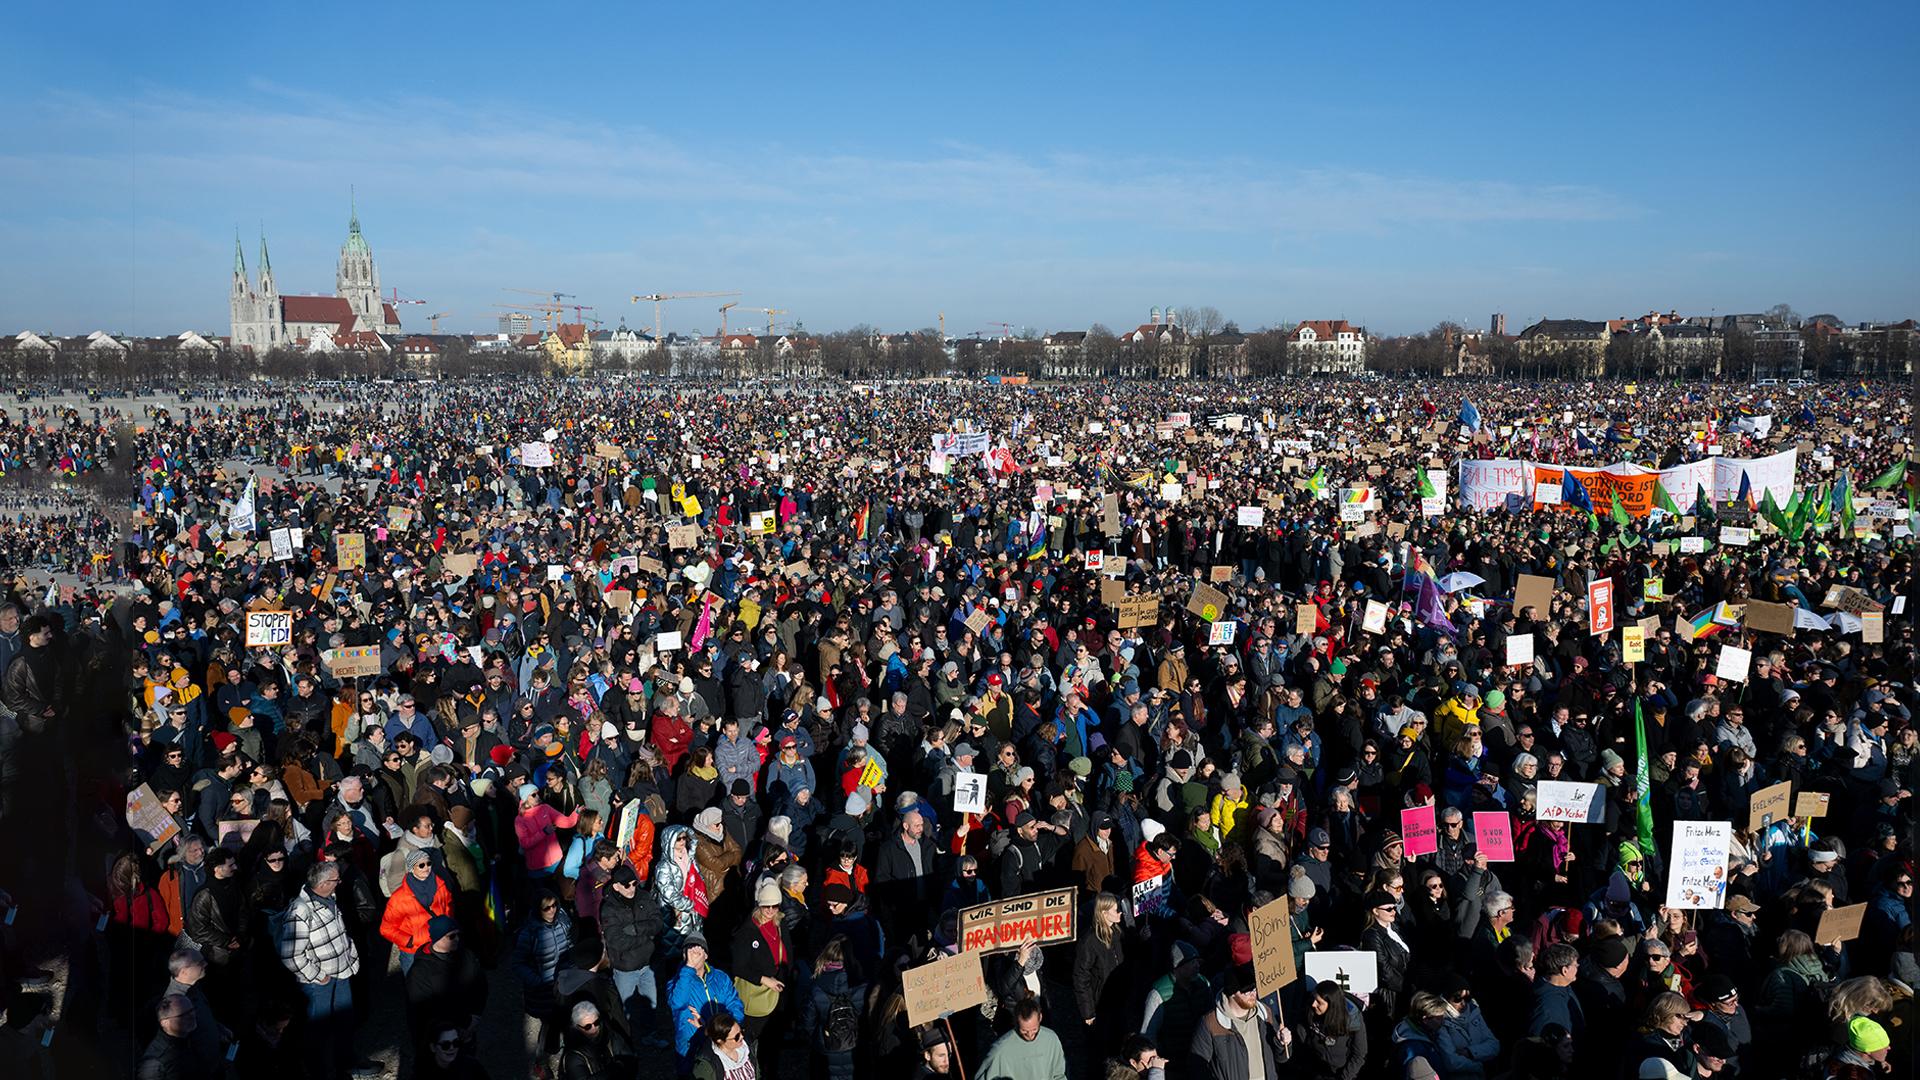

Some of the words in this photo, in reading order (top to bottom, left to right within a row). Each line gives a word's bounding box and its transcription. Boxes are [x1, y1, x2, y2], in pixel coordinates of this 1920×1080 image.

[249, 613, 290, 627] STOPPT
[1211, 632, 1232, 640] FALT
[969, 907, 994, 920] WIR
[1002, 901, 1033, 914] SIND
[1046, 896, 1066, 907] DIE
[965, 912, 1071, 952] BRANDMAUER!
